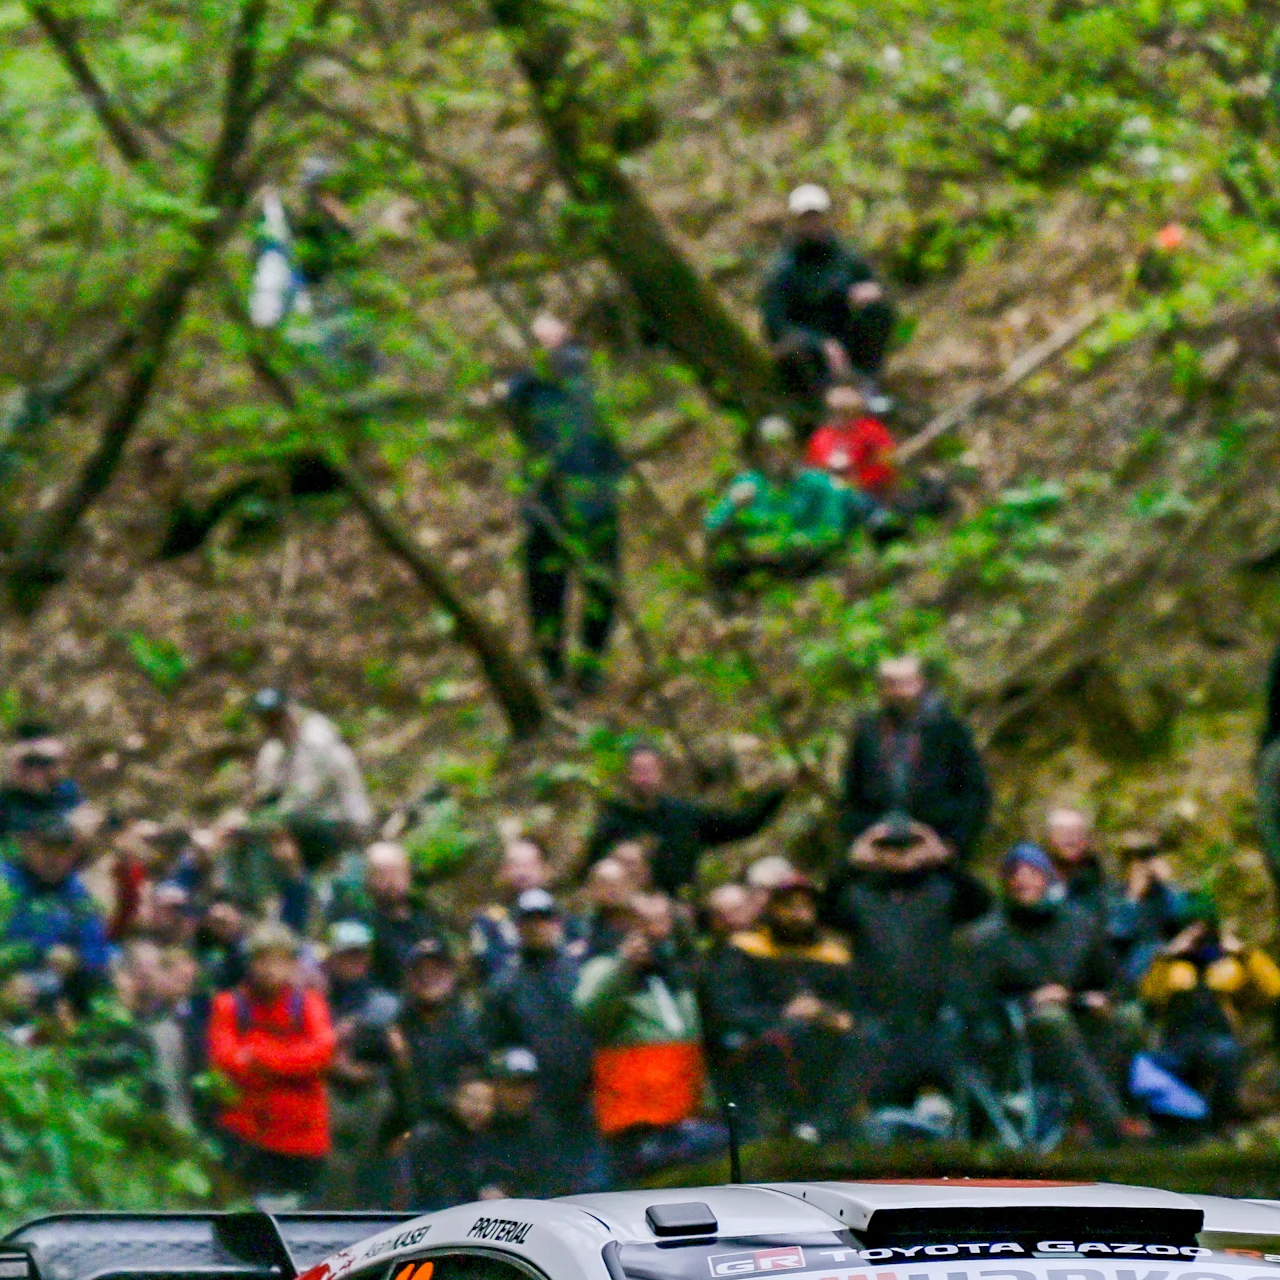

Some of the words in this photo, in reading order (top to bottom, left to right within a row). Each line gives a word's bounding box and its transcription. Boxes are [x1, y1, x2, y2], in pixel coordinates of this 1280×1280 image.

[466, 1217, 534, 1245] PROTERIAL
[715, 1254, 801, 1275] GR
[820, 1241, 1025, 1263] TOYOTA
[1036, 1240, 1213, 1257] GAZOO
